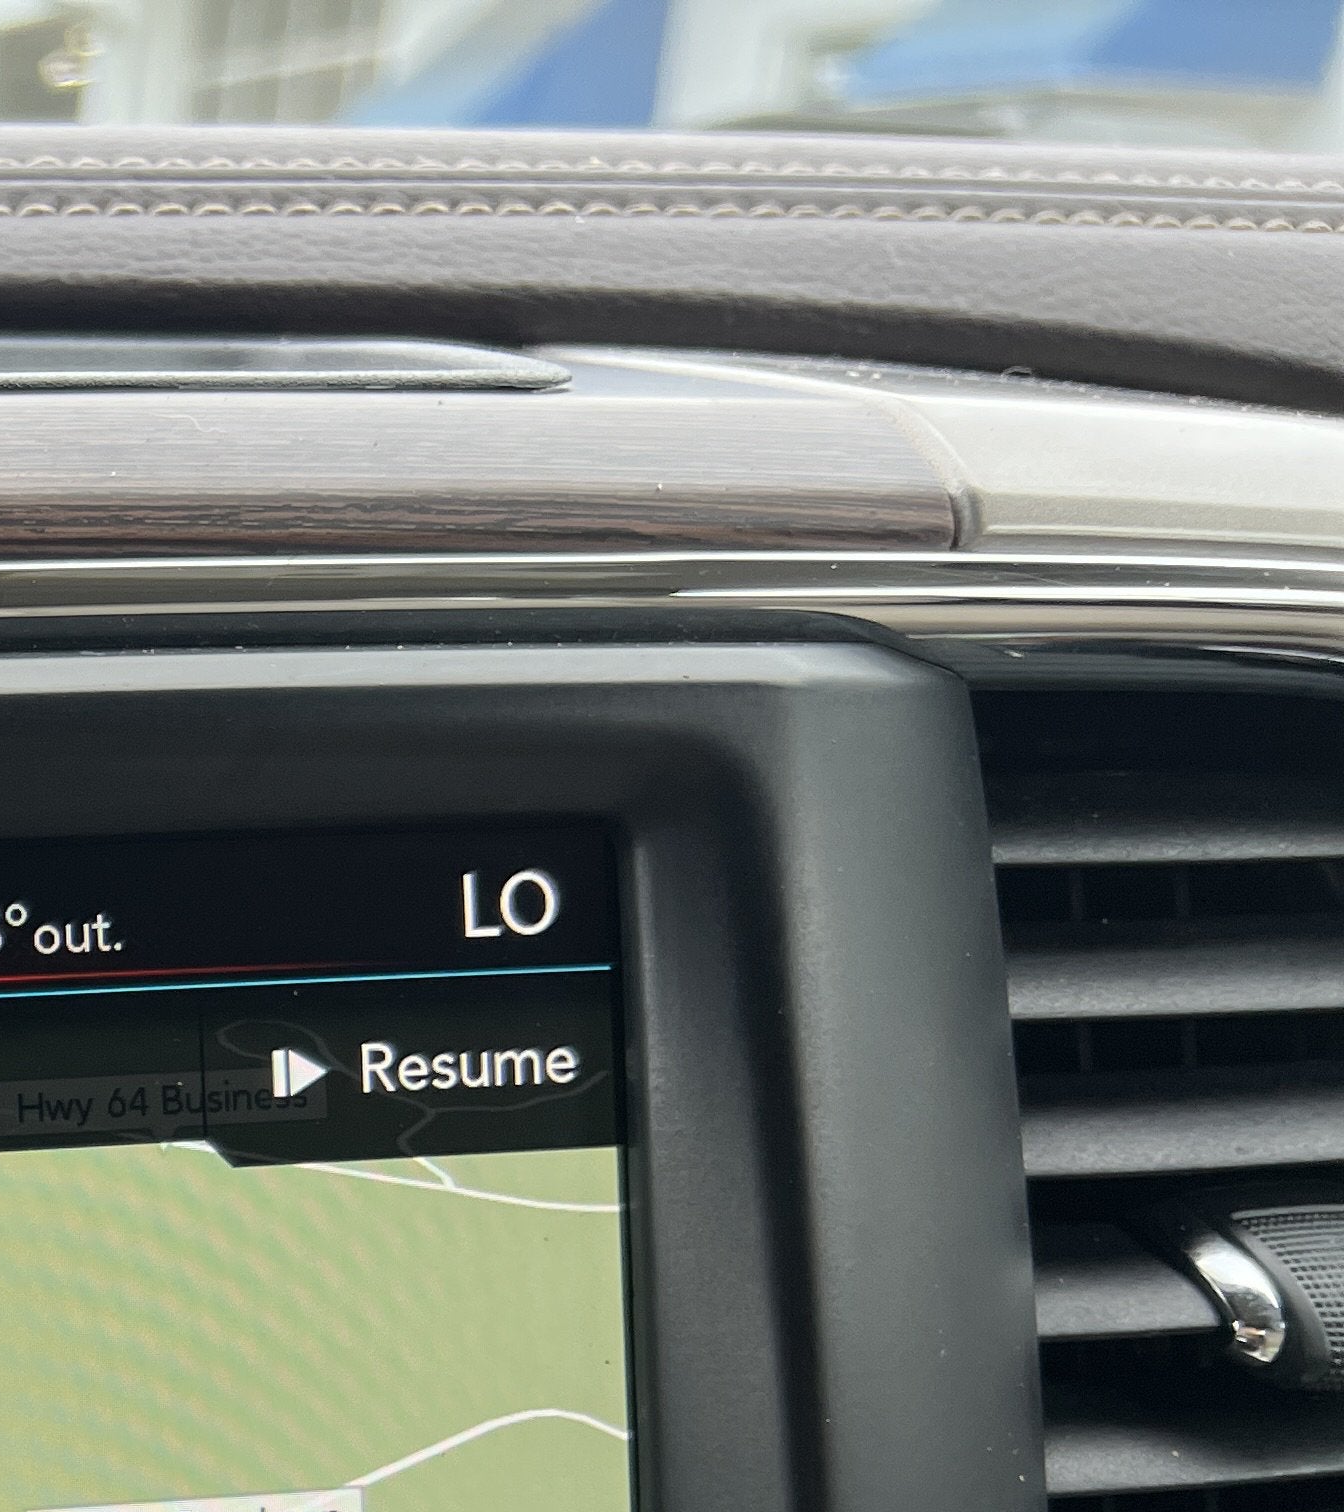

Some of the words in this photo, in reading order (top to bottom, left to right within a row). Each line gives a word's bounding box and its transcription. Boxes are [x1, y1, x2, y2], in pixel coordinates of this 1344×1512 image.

[462, 870, 559, 938] LO
[360, 1042, 579, 1094] Resume
[16, 1091, 94, 1127] Hwy
[107, 1083, 149, 1120] 64
